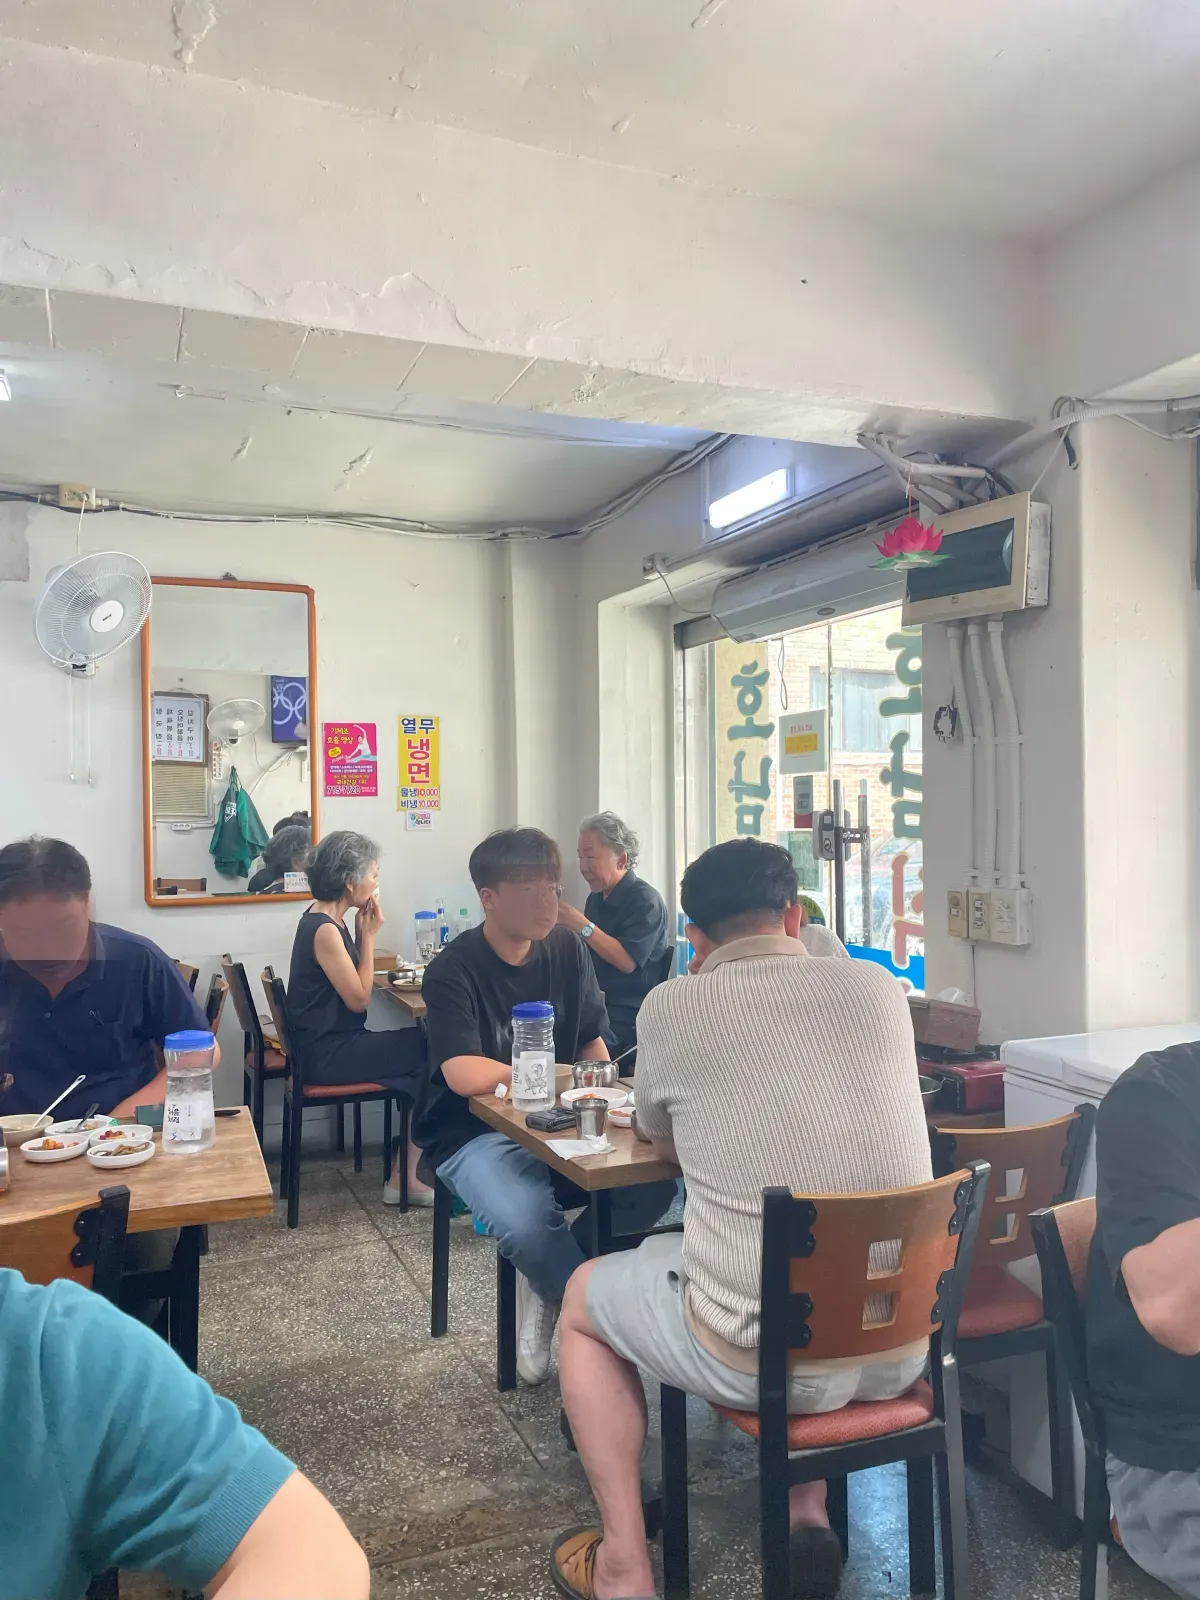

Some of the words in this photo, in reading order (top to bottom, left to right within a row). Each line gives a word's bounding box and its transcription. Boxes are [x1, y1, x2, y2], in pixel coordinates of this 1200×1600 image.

[401, 717, 436, 735] 열무
[341, 736, 353, 745] 명상
[407, 738, 431, 784] 냉면
[417, 788, 438, 798] 10,000
[401, 800, 417, 808] 비냉
[418, 799, 439, 809] 10,000
